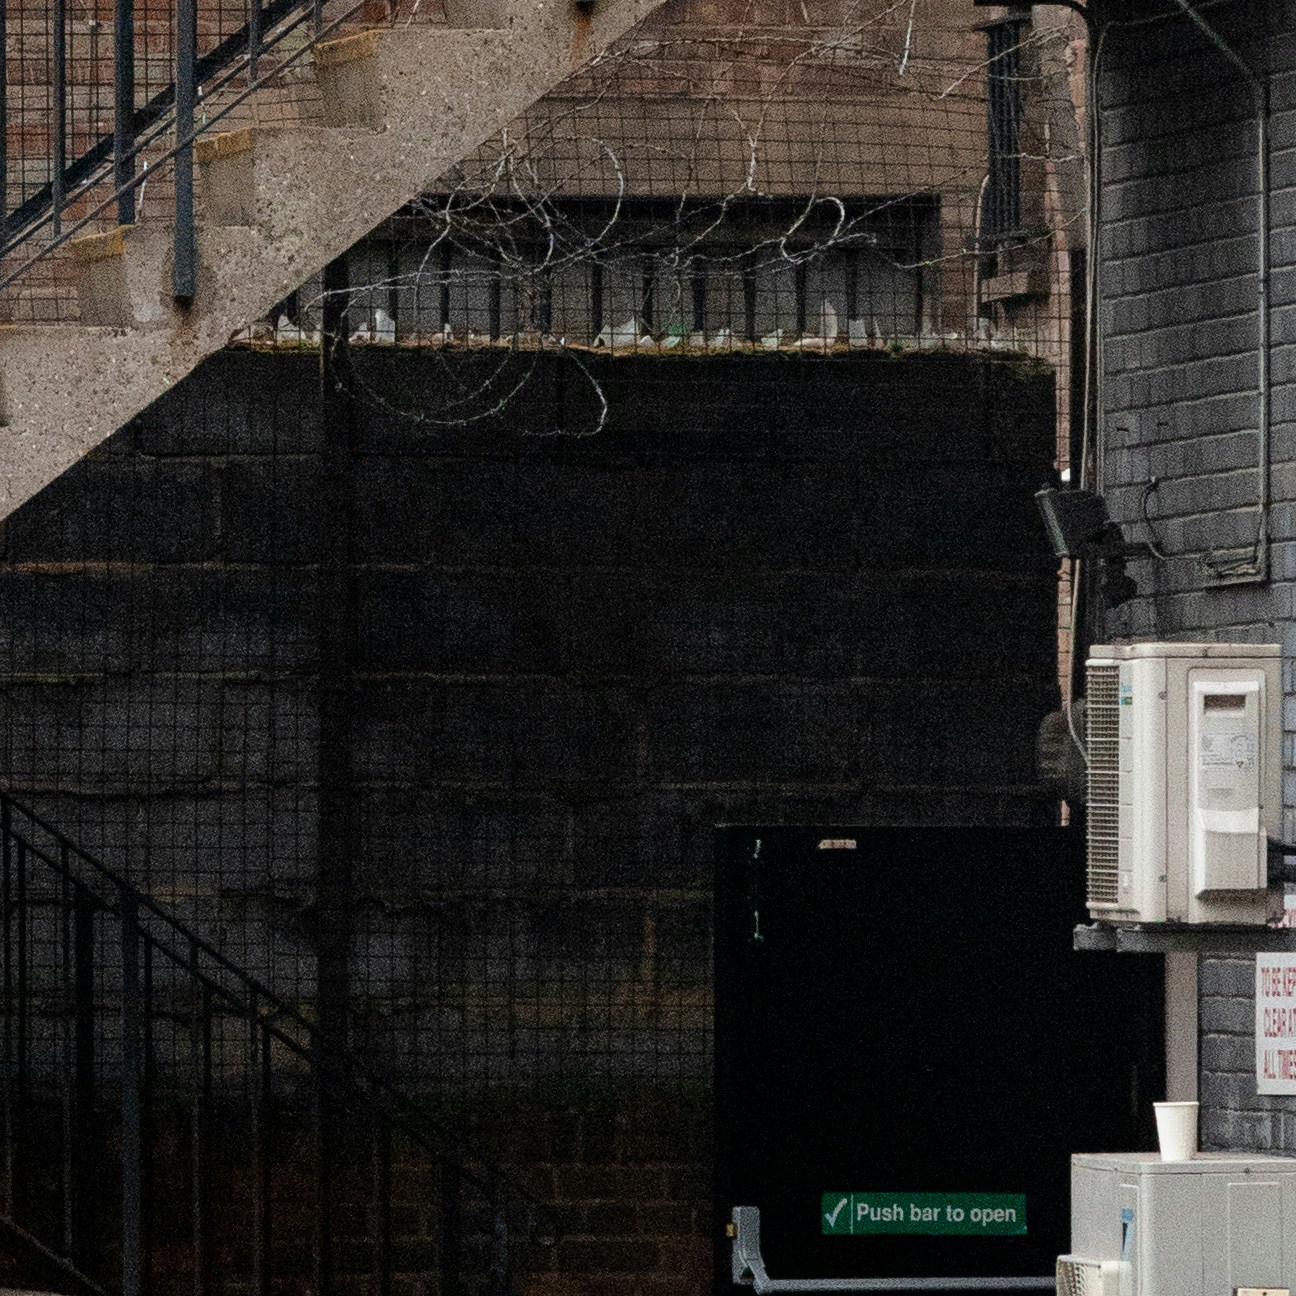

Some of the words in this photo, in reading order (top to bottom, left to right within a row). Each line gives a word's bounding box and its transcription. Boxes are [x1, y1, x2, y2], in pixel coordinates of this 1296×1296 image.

[856, 1202, 905, 1222] Push
[910, 1203, 941, 1222] bar
[946, 1205, 964, 1223] to
[970, 1206, 1017, 1227] open
